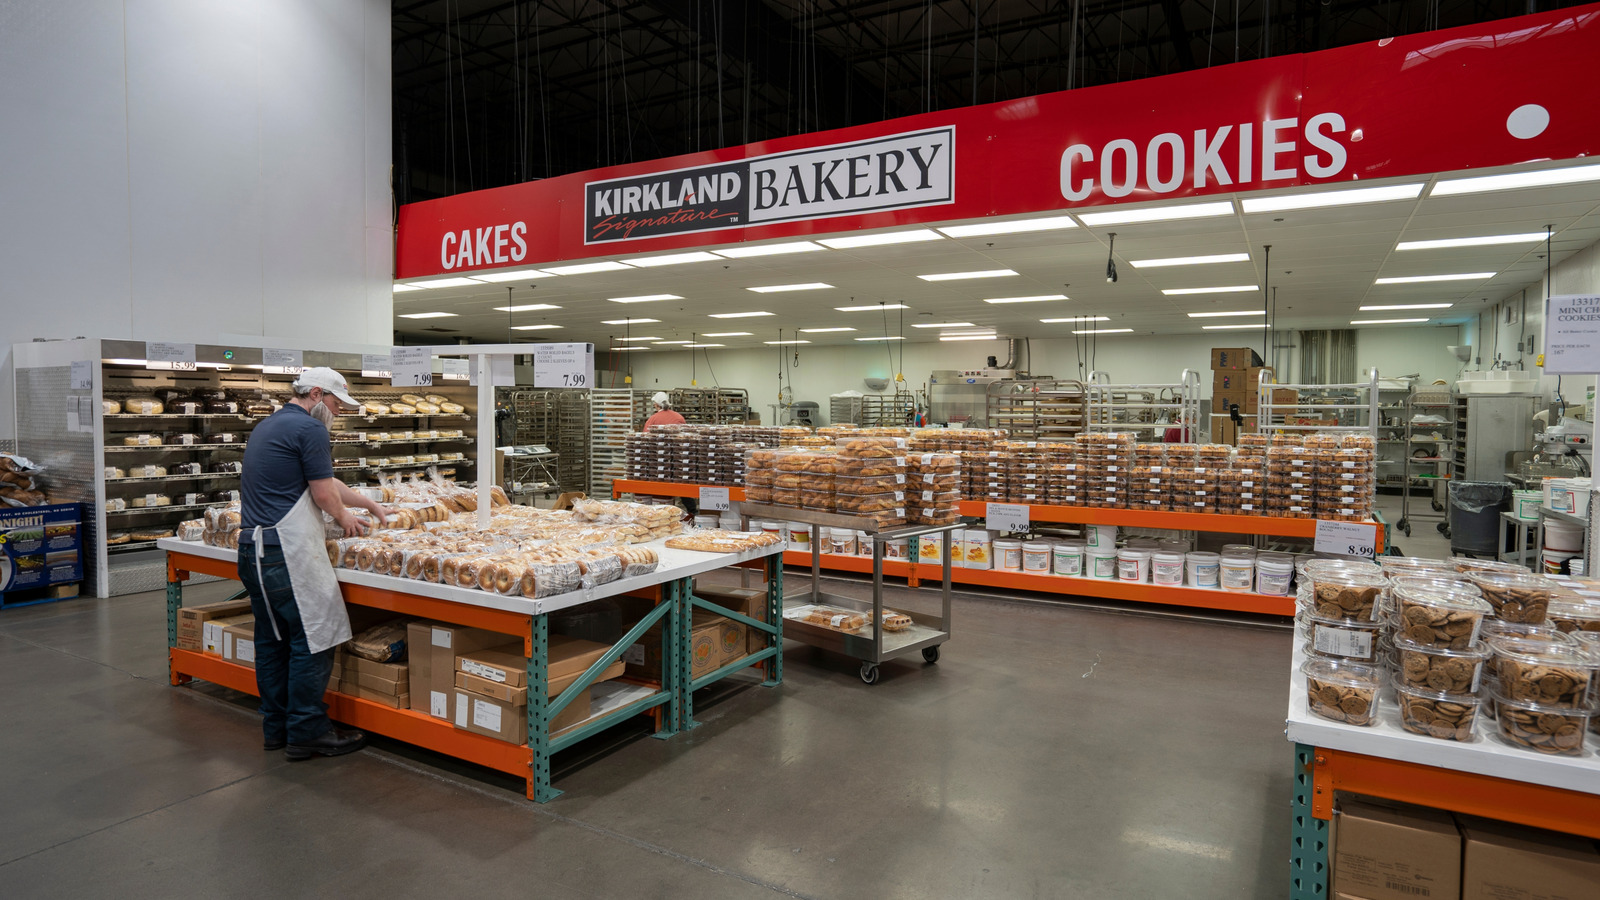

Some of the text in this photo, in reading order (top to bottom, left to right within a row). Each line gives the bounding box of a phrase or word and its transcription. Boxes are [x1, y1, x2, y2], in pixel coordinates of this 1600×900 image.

[1059, 112, 1347, 202] COOKIES
[753, 143, 943, 211] BAKERY
[594, 171, 742, 218] KIRKLAND
[592, 205, 739, 240] Signature
[441, 221, 527, 270] CAKES
[170, 361, 196, 370] 15.99
[282, 366, 302, 374] 15.99
[414, 374, 431, 385] 7.99
[563, 374, 586, 386] 7.99
[716, 502, 729, 510] 9.99
[0, 515, 43, 527] NIGHT!
[1010, 523, 1029, 532] 9.99
[1348, 545, 1374, 556] 8.99
